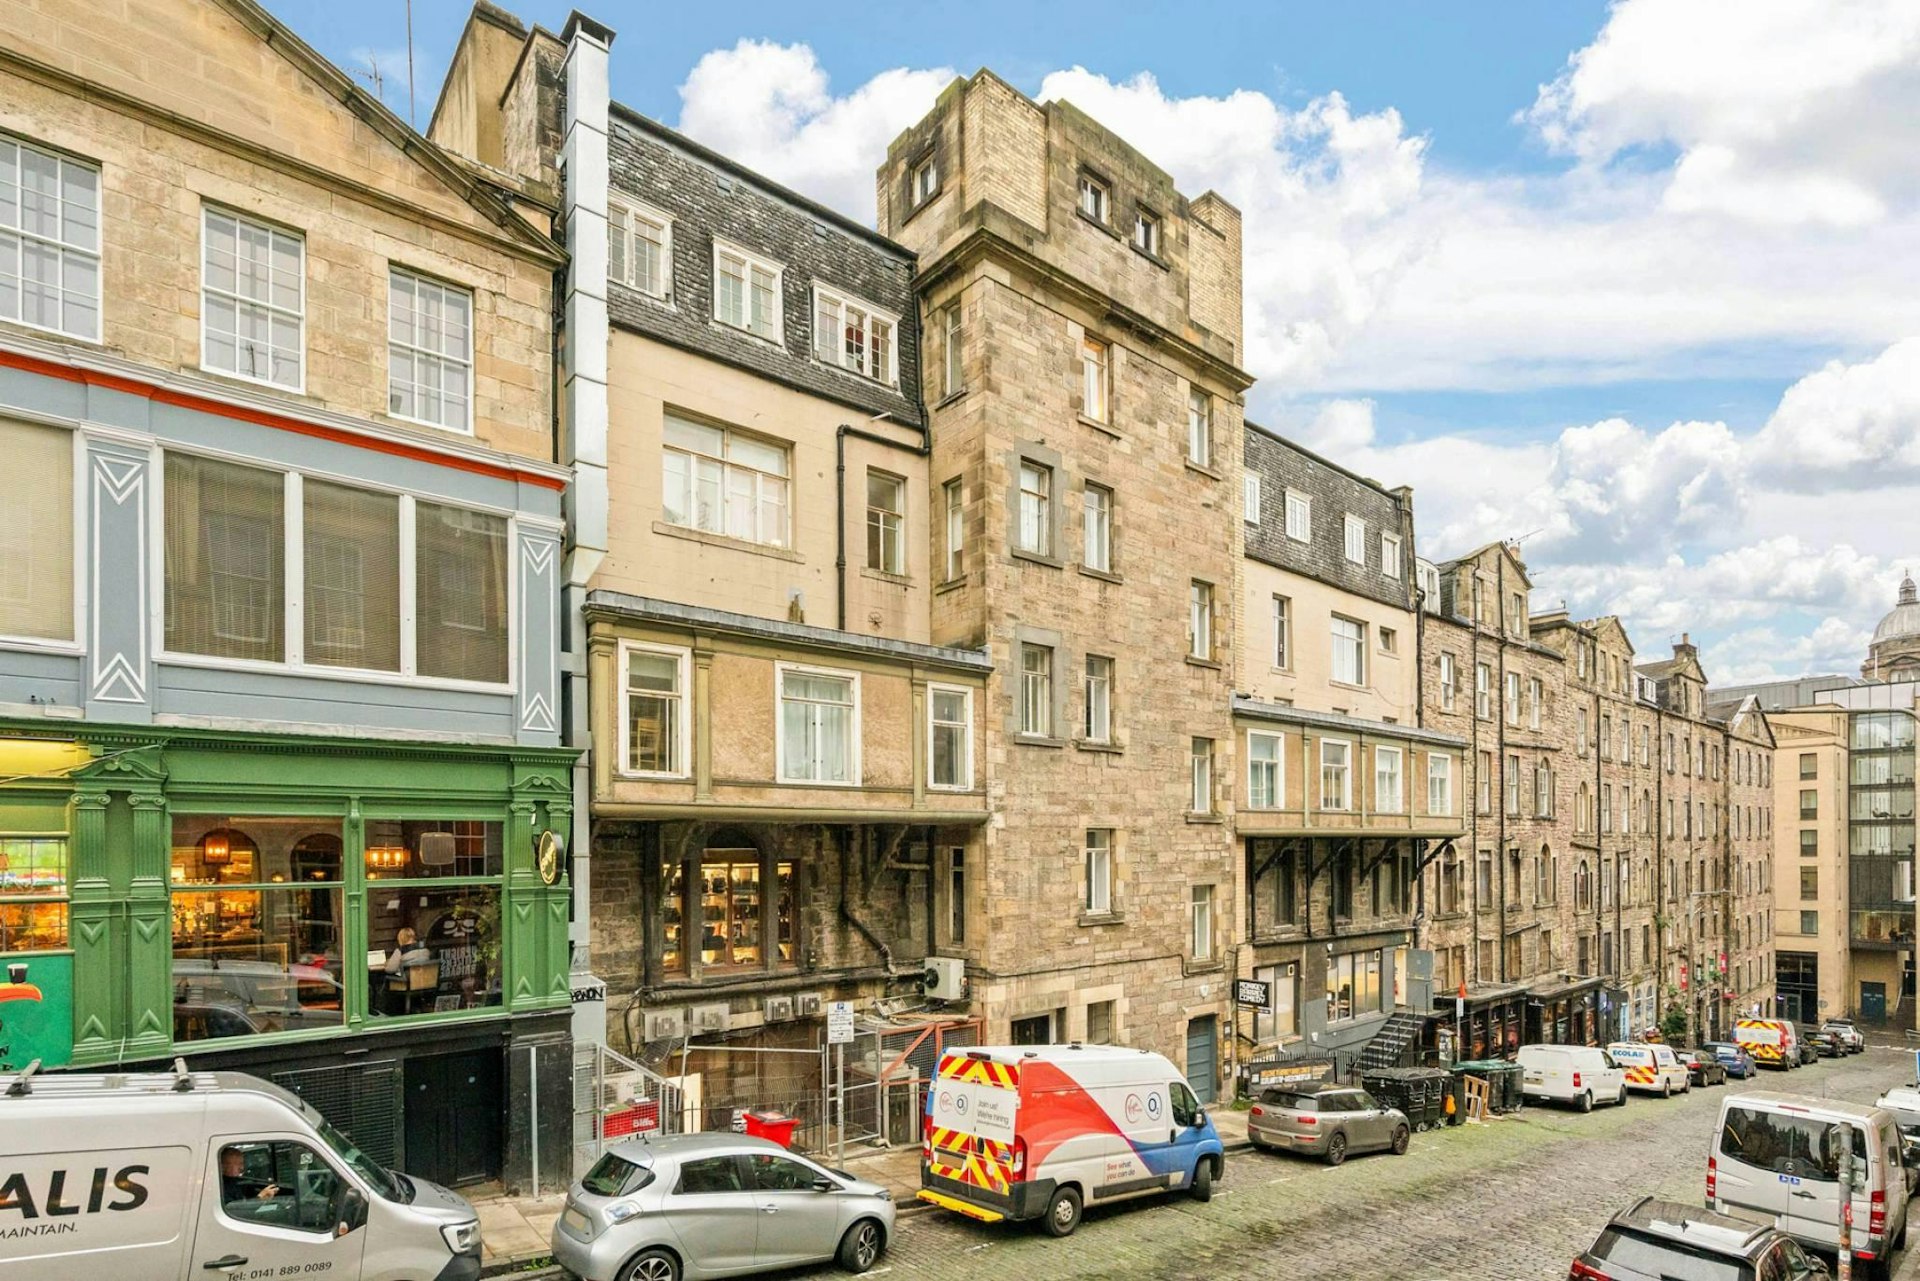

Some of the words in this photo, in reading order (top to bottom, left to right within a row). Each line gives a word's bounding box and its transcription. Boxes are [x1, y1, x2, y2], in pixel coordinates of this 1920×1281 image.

[1107, 1163, 1117, 1171] See
[1118, 1160, 1132, 1169] what
[1106, 1172, 1117, 1181] you
[1117, 1170, 1128, 1179] can
[1128, 1168, 1136, 1177] do
[0, 1165, 149, 1219] ALIS
[228, 1271, 247, 1281] Tel:
[250, 1267, 274, 1280] 0141
[279, 1264, 301, 1276] 889
[304, 1260, 332, 1273] 0089
